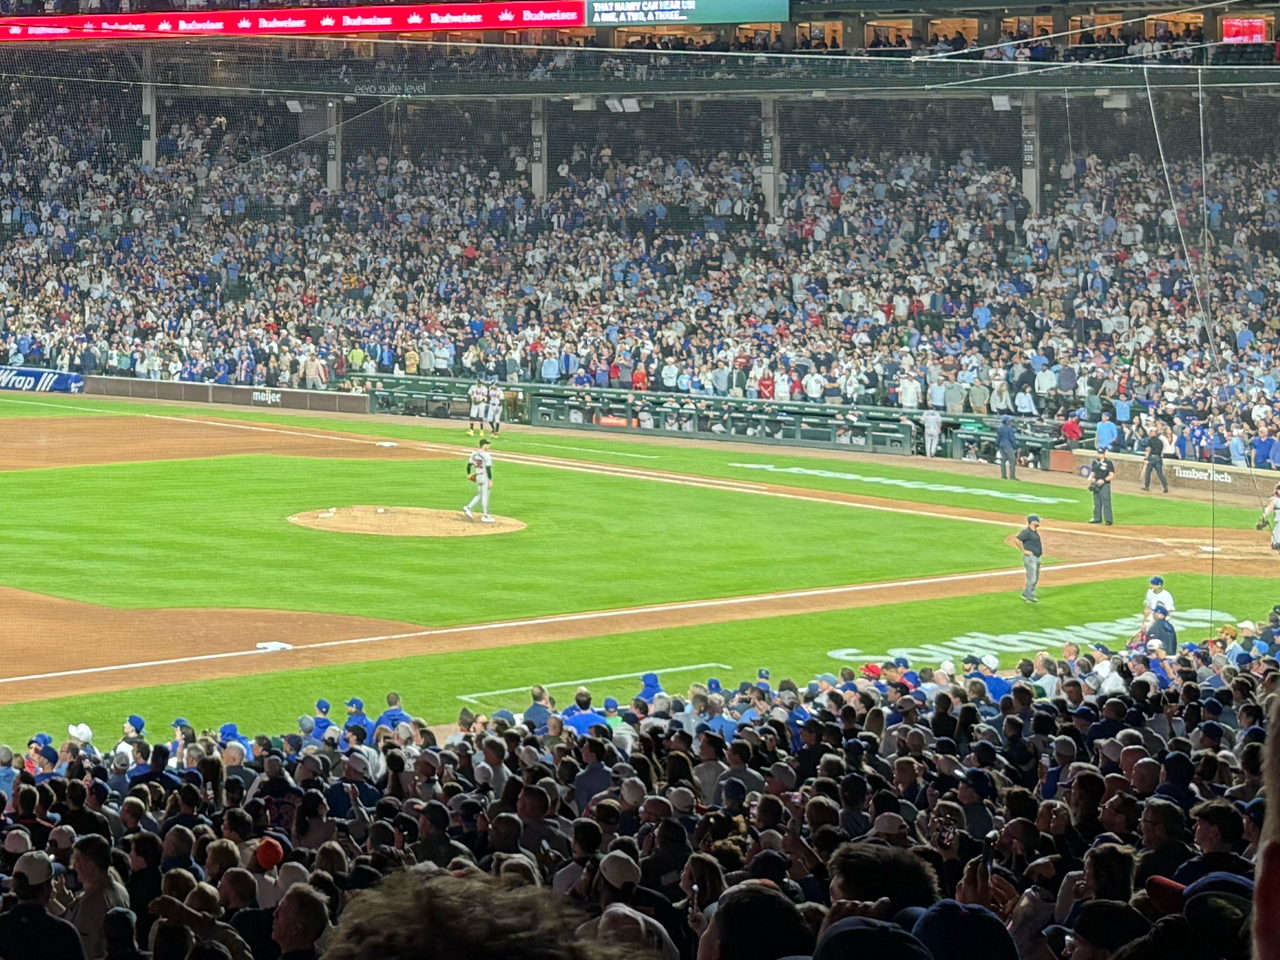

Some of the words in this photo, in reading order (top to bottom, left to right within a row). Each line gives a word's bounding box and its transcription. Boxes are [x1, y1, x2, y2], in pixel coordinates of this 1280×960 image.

[430, 12, 483, 24] Budweiser
[522, 9, 577, 21] Budweiser
[378, 82, 401, 94] suite
[404, 82, 426, 94] level
[252, 390, 281, 404] meijer
[1173, 466, 1232, 483] TimberTech
